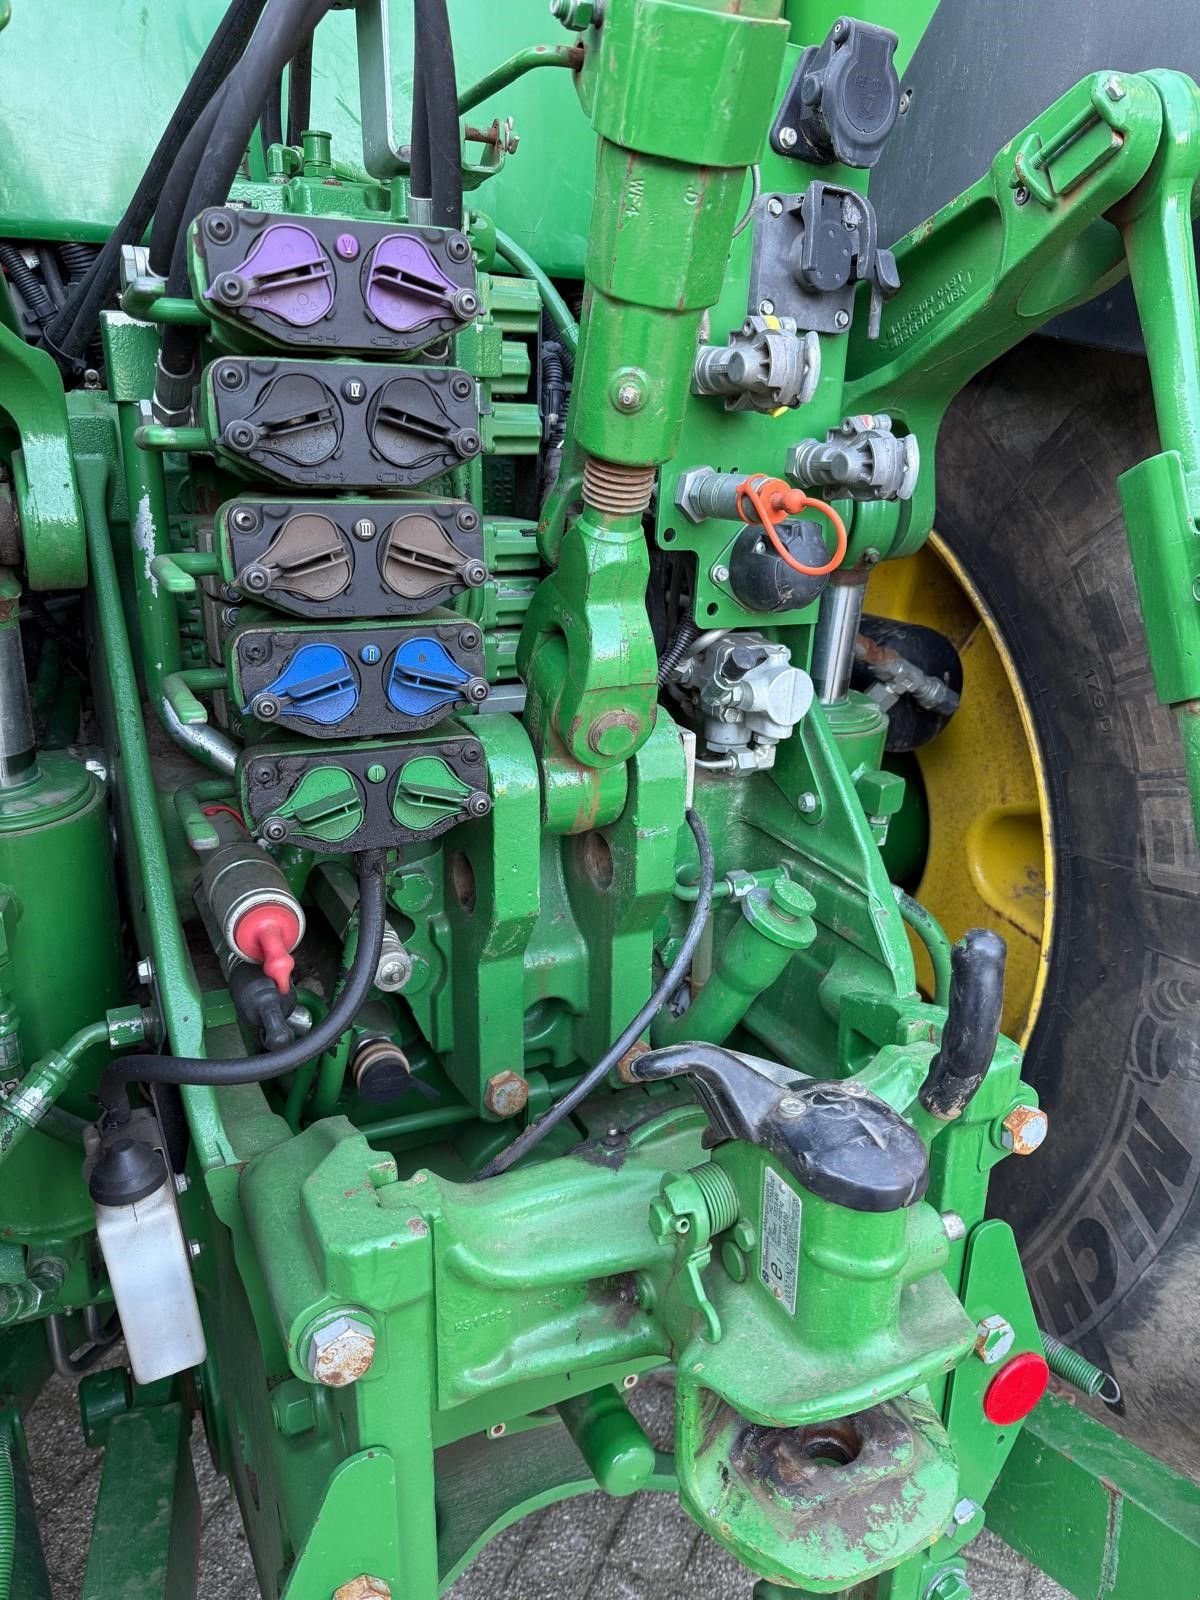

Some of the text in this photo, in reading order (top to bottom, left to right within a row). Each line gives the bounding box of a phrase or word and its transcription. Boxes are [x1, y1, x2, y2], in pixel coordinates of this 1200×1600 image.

[342, 239, 354, 255] V
[350, 382, 361, 398] IV
[360, 521, 372, 536] III
